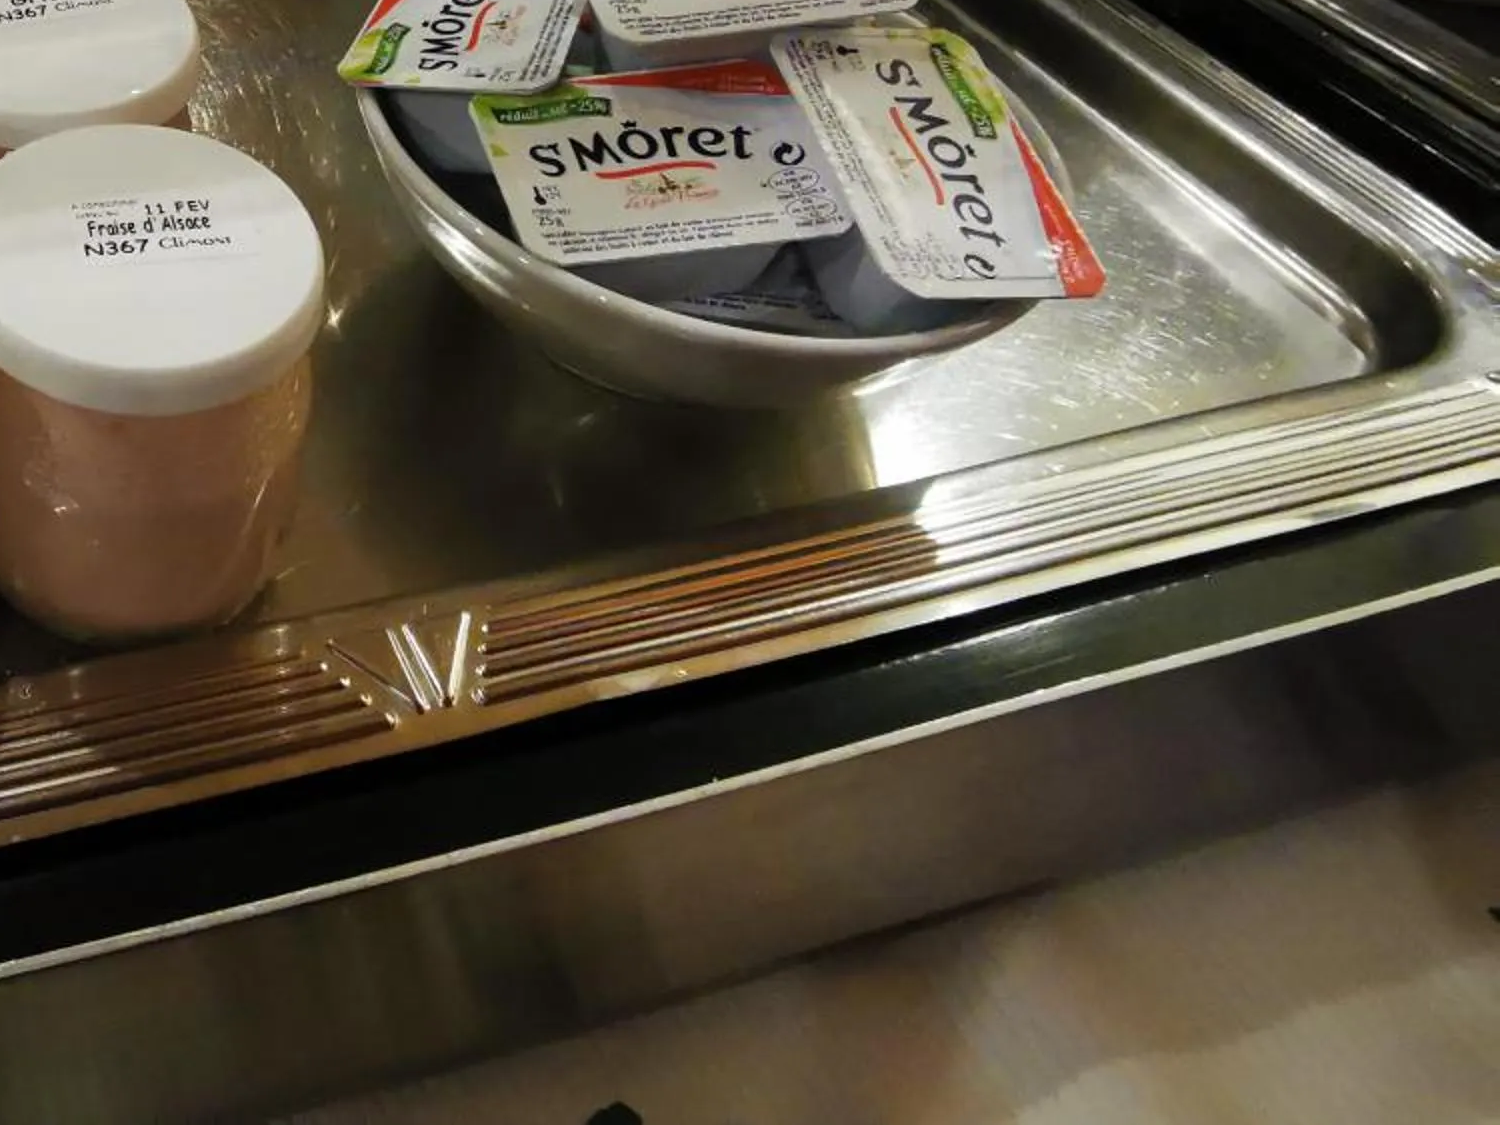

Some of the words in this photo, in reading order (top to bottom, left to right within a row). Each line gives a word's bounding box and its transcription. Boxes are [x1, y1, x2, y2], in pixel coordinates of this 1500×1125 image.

[143, 202, 167, 216] 11
[173, 198, 210, 213] FEV
[87, 219, 138, 238] Fraise
[83, 237, 149, 258] N367
